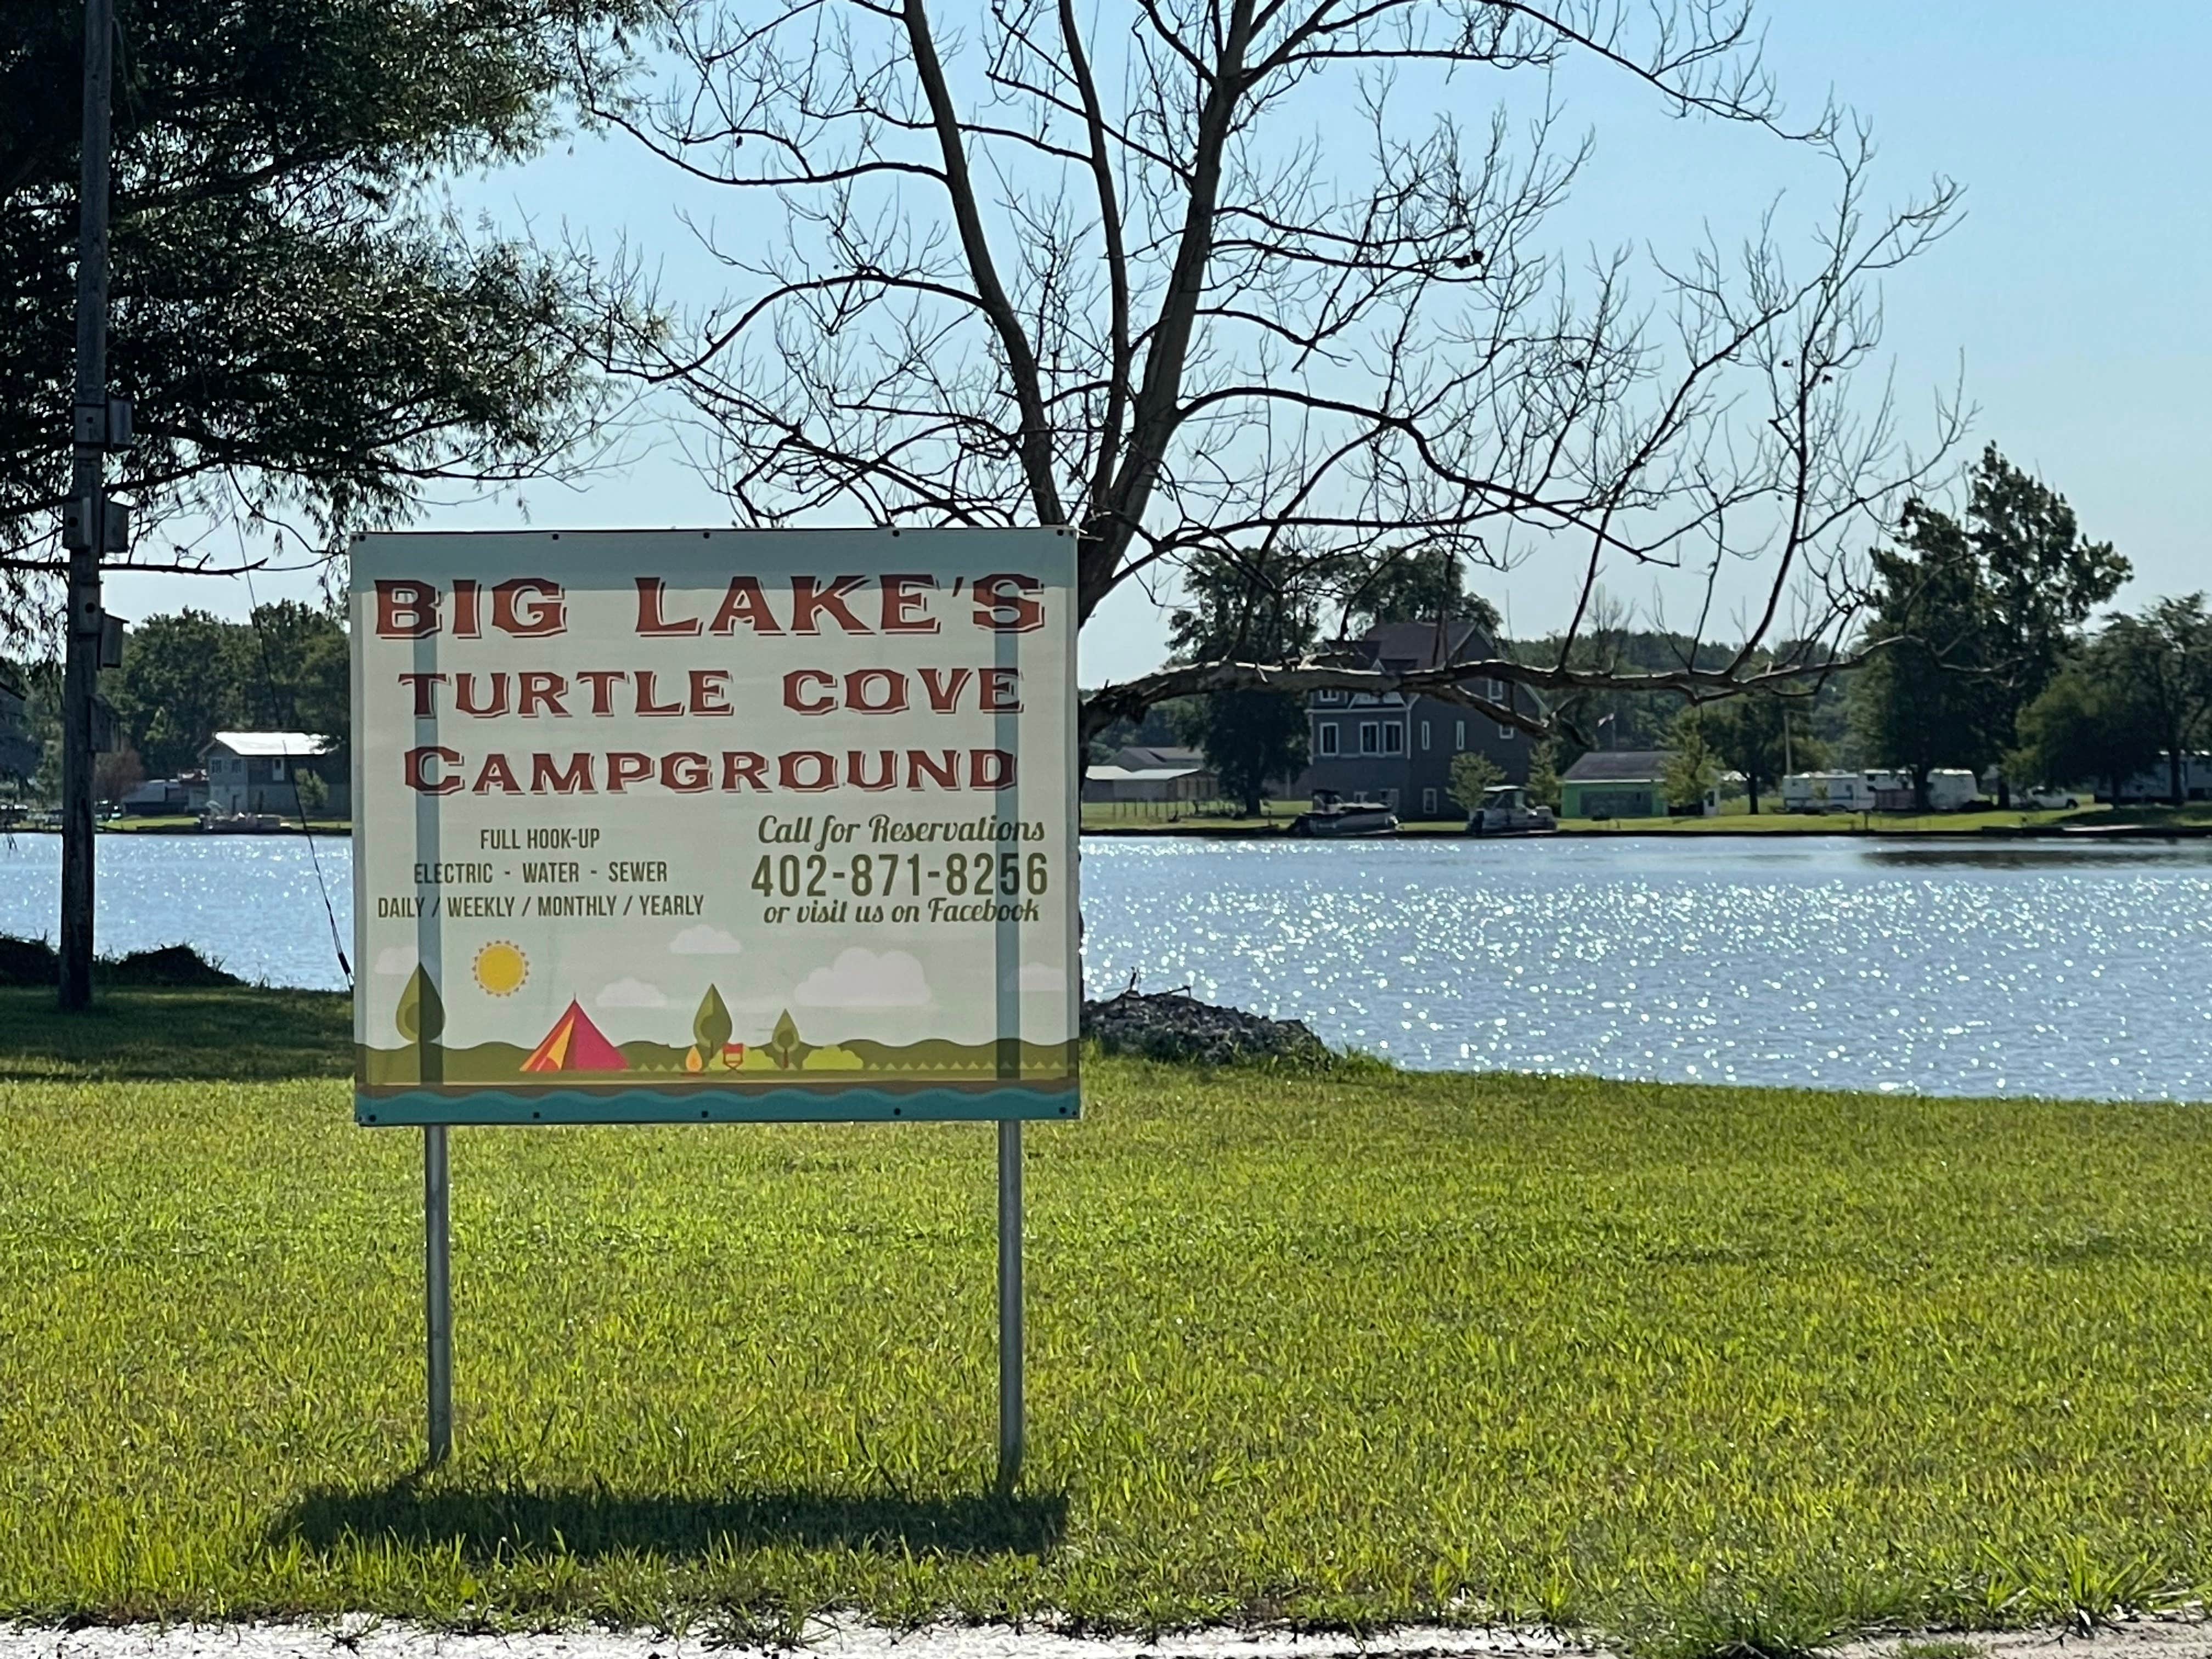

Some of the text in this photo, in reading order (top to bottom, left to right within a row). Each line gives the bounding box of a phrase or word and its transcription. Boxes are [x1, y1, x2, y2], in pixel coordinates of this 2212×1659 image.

[375, 574, 1045, 639] BIG LAKE'S
[398, 668, 1024, 719] TURTLE COVE
[404, 746, 1017, 795] CAMPGROUND
[481, 828, 600, 849] FULL HOOK-UP
[758, 814, 1045, 851] Call for Reservations
[414, 863, 493, 884] ELECTRIC
[523, 862, 579, 883] WATER
[608, 861, 668, 882] SEWER
[751, 852, 1047, 897] 402-871-8256
[378, 897, 424, 918] DAILY
[447, 896, 516, 917] WEEKLY
[538, 895, 617, 916] MONTHLY
[640, 895, 704, 916] YEARLY
[763, 897, 1040, 923] or visit us on Facebook
